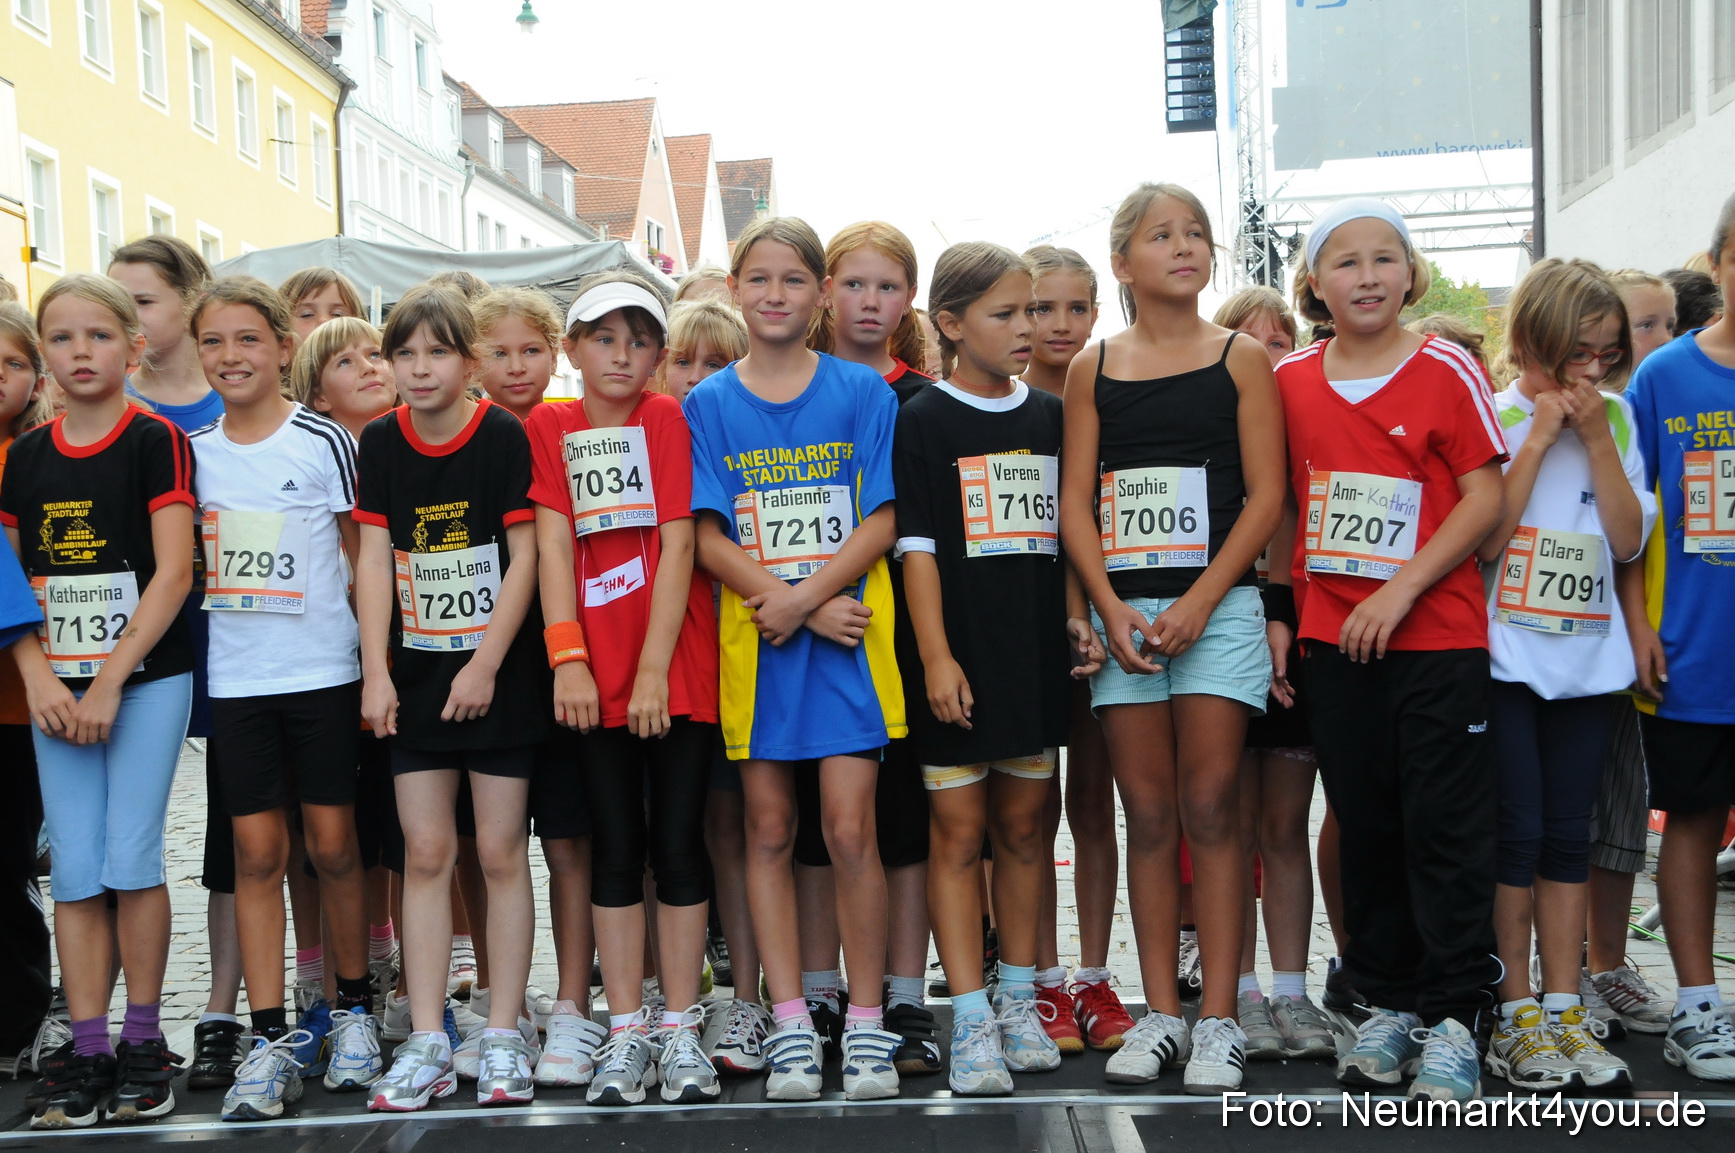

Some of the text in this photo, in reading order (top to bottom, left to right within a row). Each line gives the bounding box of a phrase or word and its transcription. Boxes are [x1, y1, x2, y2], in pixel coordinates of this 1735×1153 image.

[1377, 140, 1523, 158] wwwbarowski
[1664, 416, 1693, 434] 10.
[1693, 430, 1735, 448] STA
[566, 438, 631, 462] Christina
[742, 461, 840, 486] STADTLAUF
[993, 462, 1040, 481] Verena
[1721, 460, 1735, 478] C
[572, 465, 644, 501] 7034
[1118, 477, 1168, 500] Sophie
[43, 500, 93, 512] NEUMARKTER
[762, 489, 831, 509] Fabienne
[968, 493, 1054, 521] K5 7165
[1332, 481, 1416, 516] Ann- Kathrin
[1690, 490, 1706, 505] K5
[47, 509, 90, 518] STADTLAUF
[416, 501, 470, 515] NEUMARKTER
[420, 510, 465, 522] STADTLAUF
[612, 510, 656, 521] PFLEIDERER
[1120, 506, 1197, 536] 7006
[1308, 510, 1406, 547] K5 7207
[739, 516, 843, 548] K5 7213
[54, 540, 107, 550] BAMBINILAUF
[430, 542, 468, 552] BAMBINIL
[1540, 538, 1584, 561] Clara
[223, 550, 295, 580] 7293
[1160, 551, 1206, 560] PFLEIDERER
[416, 560, 492, 582] Anna-Lena
[1360, 560, 1402, 574] PFLEIDER
[604, 574, 625, 595] EHN
[1506, 564, 1604, 603] K5 7091
[50, 585, 123, 604] Katharina
[254, 596, 302, 608] PFLEIDERER
[400, 586, 494, 620] K5 7203
[52, 613, 129, 644] 7132
